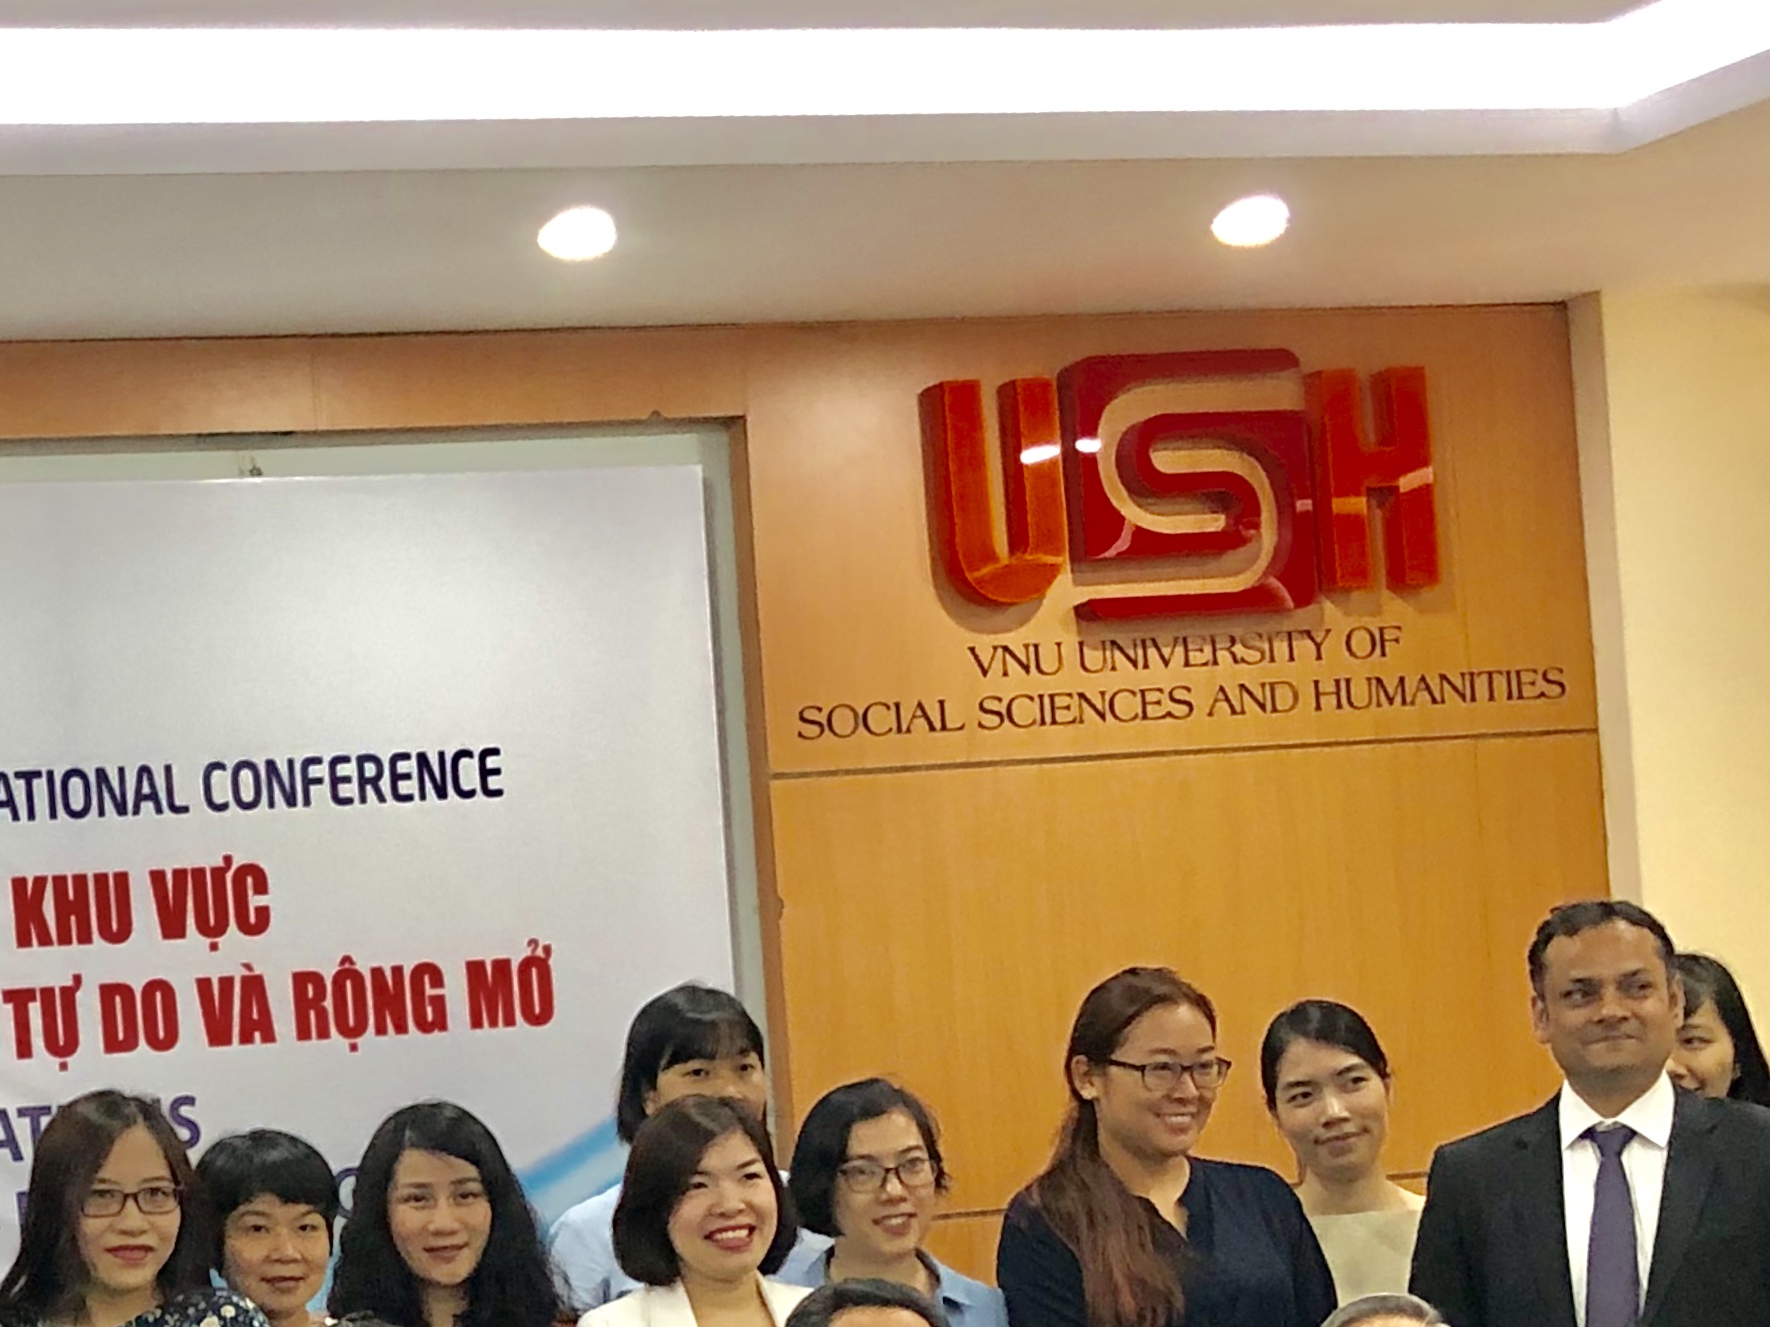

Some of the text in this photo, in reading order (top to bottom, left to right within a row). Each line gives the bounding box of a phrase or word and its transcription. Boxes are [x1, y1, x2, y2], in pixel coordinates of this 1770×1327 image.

[967, 626, 1402, 678] VNU UNIVERSITY OF
[798, 667, 1566, 740] SOCIAL SCIENCES AND HUMANITIES
[203, 747, 504, 812] CONFERENCE
[11, 871, 133, 948] KHU
[149, 855, 270, 952] VỰC
[2, 974, 82, 1071] TỰ
[99, 978, 179, 1054] DO
[195, 963, 276, 1047] VÀ
[292, 955, 448, 1052] RỘNG
[465, 938, 554, 1029] MỞ
